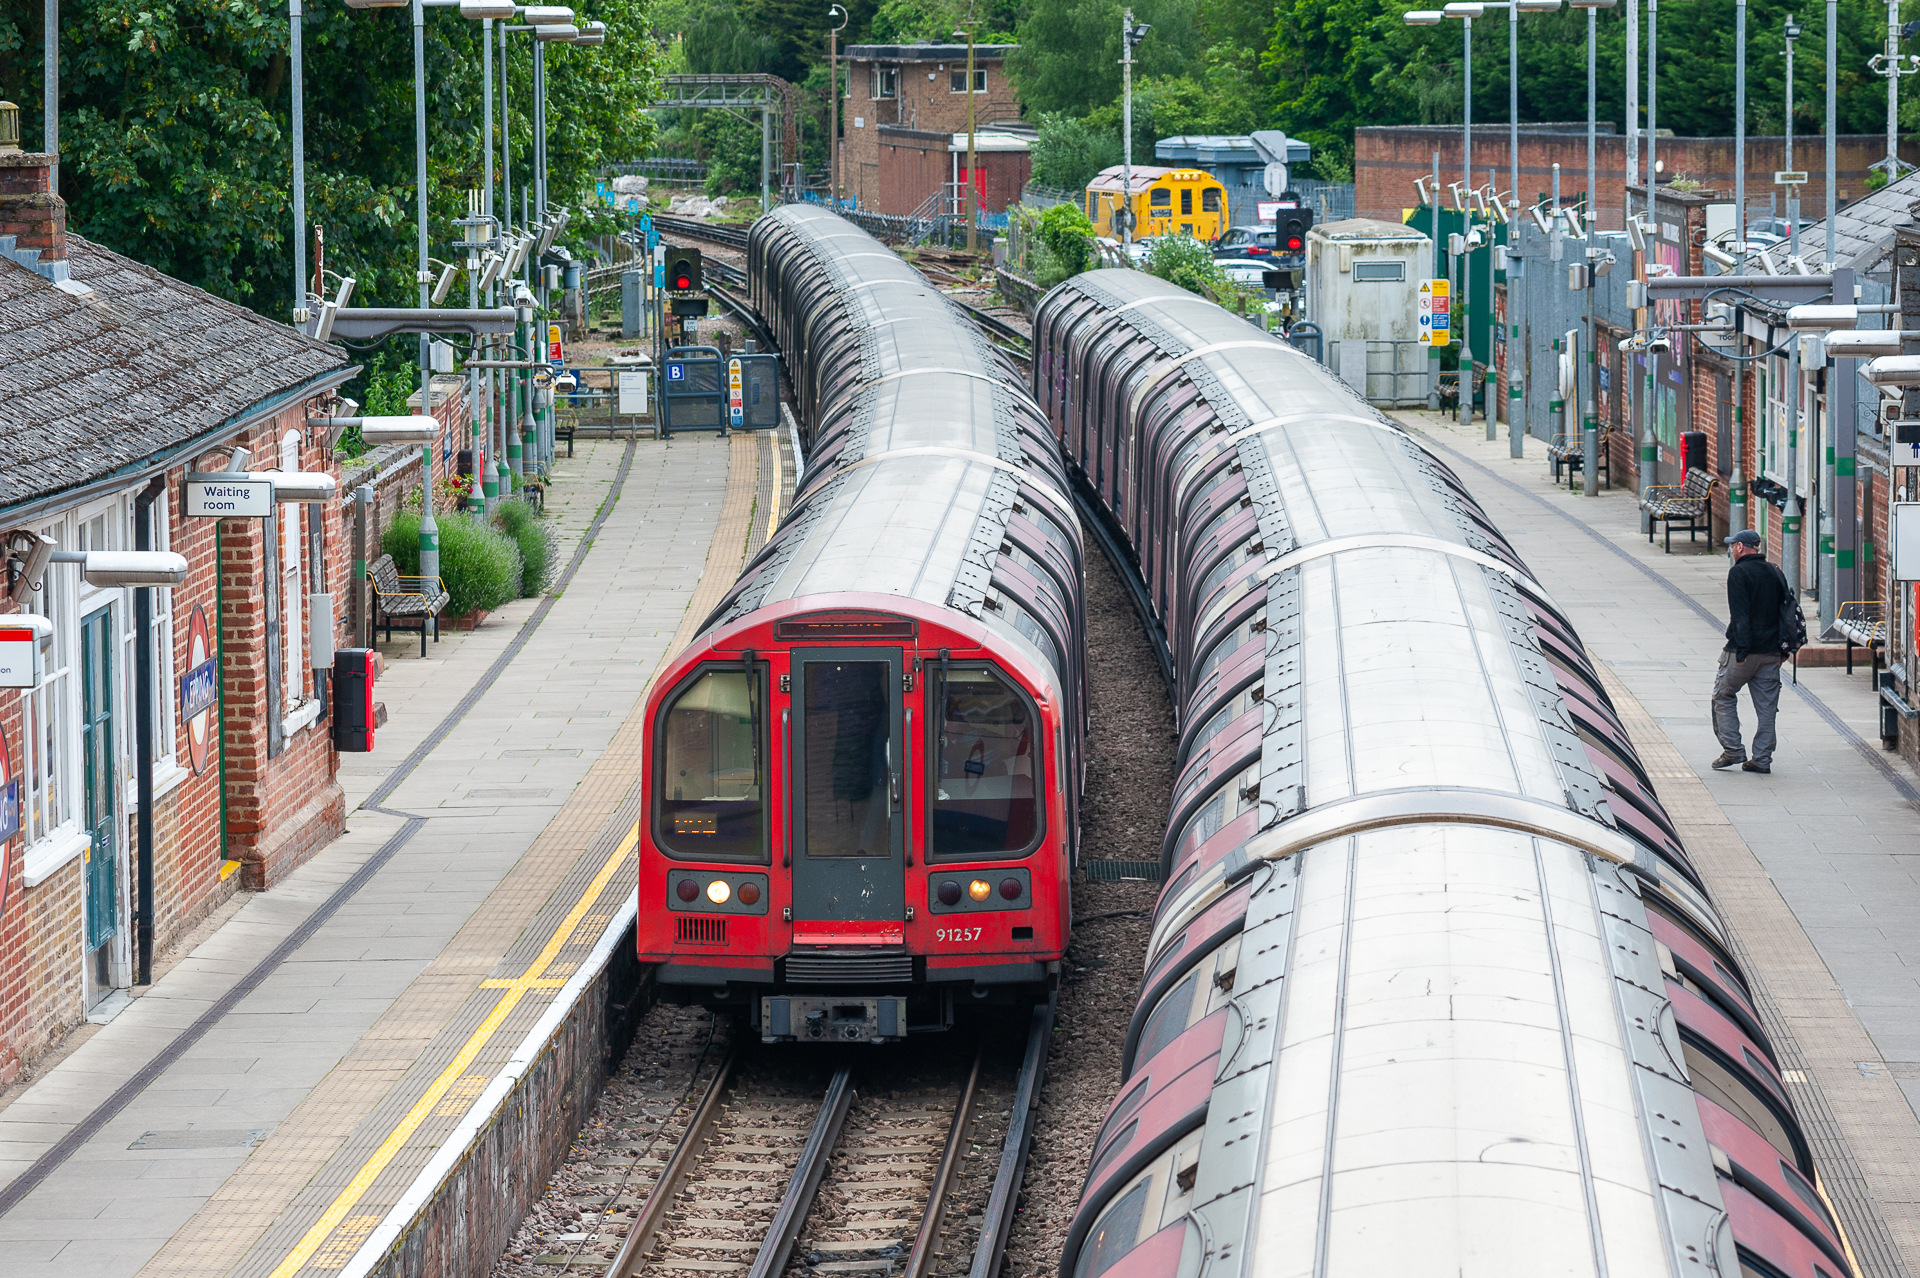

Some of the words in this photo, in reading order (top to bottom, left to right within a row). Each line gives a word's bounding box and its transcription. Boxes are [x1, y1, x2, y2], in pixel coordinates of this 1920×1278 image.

[671, 366, 681, 379] B
[204, 486, 250, 500] Waiting
[203, 501, 235, 510] room
[189, 670, 210, 709] EPPING
[936, 927, 983, 942] 91257
